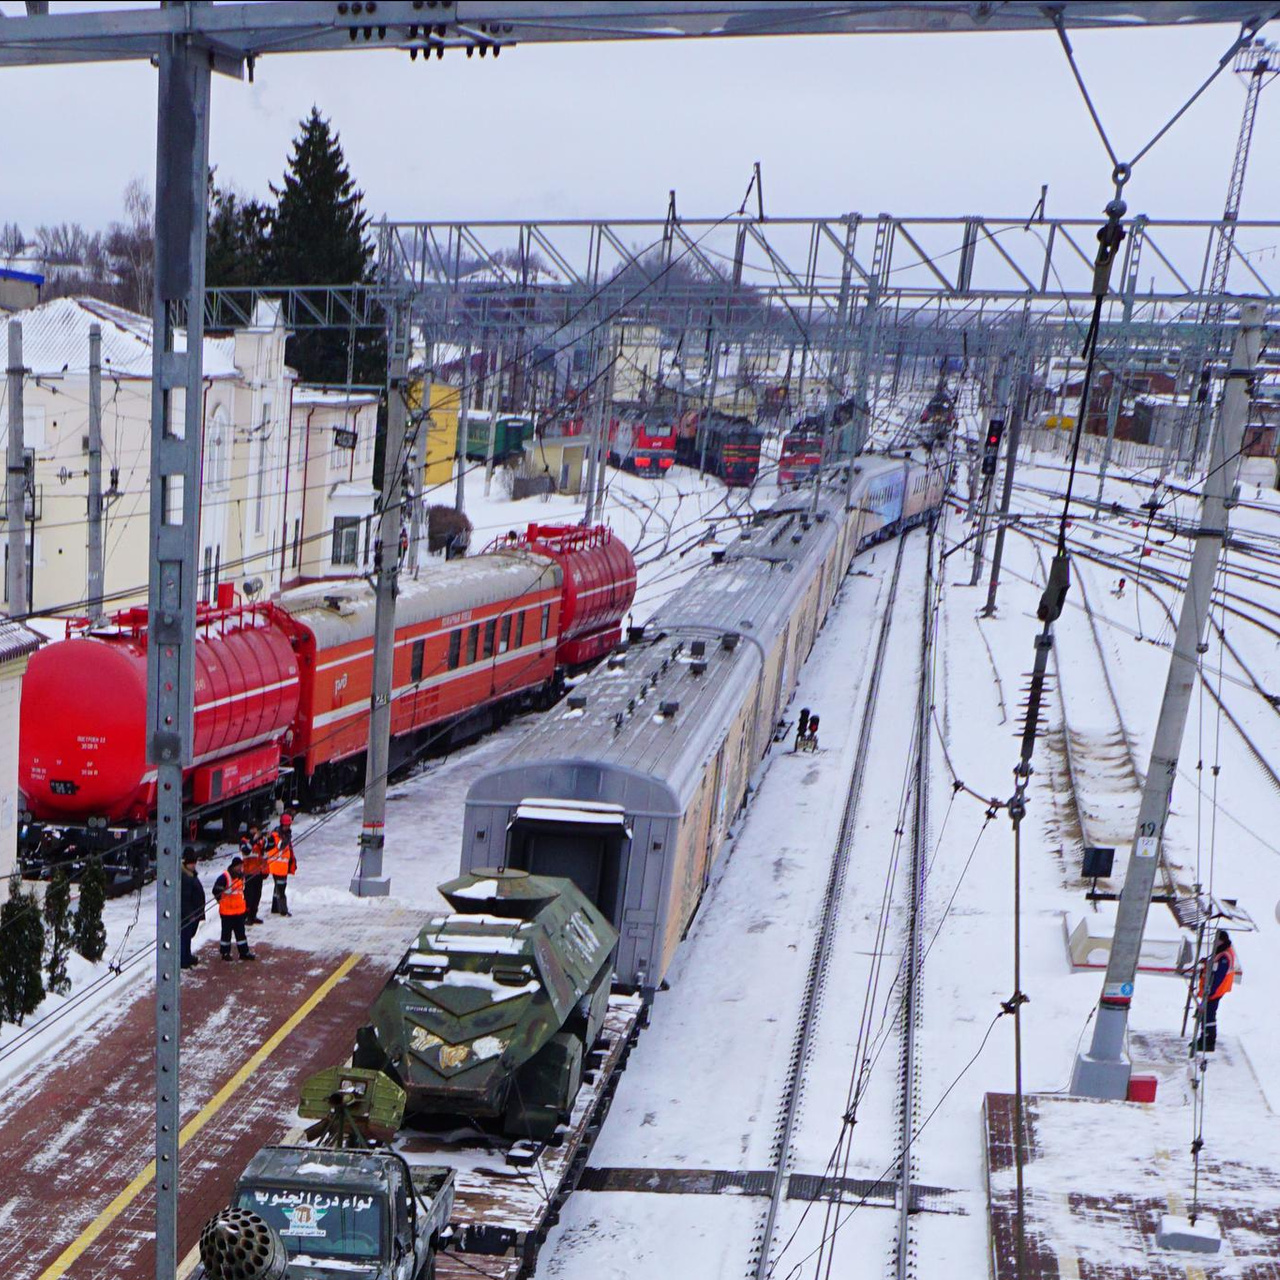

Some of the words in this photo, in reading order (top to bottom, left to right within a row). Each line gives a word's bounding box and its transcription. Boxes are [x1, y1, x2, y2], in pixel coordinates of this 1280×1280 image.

[1140, 822, 1156, 837] 19
[254, 1190, 311, 1207] الجنوب
[313, 1194, 339, 1209] درع
[342, 1195, 373, 1212] لواء
